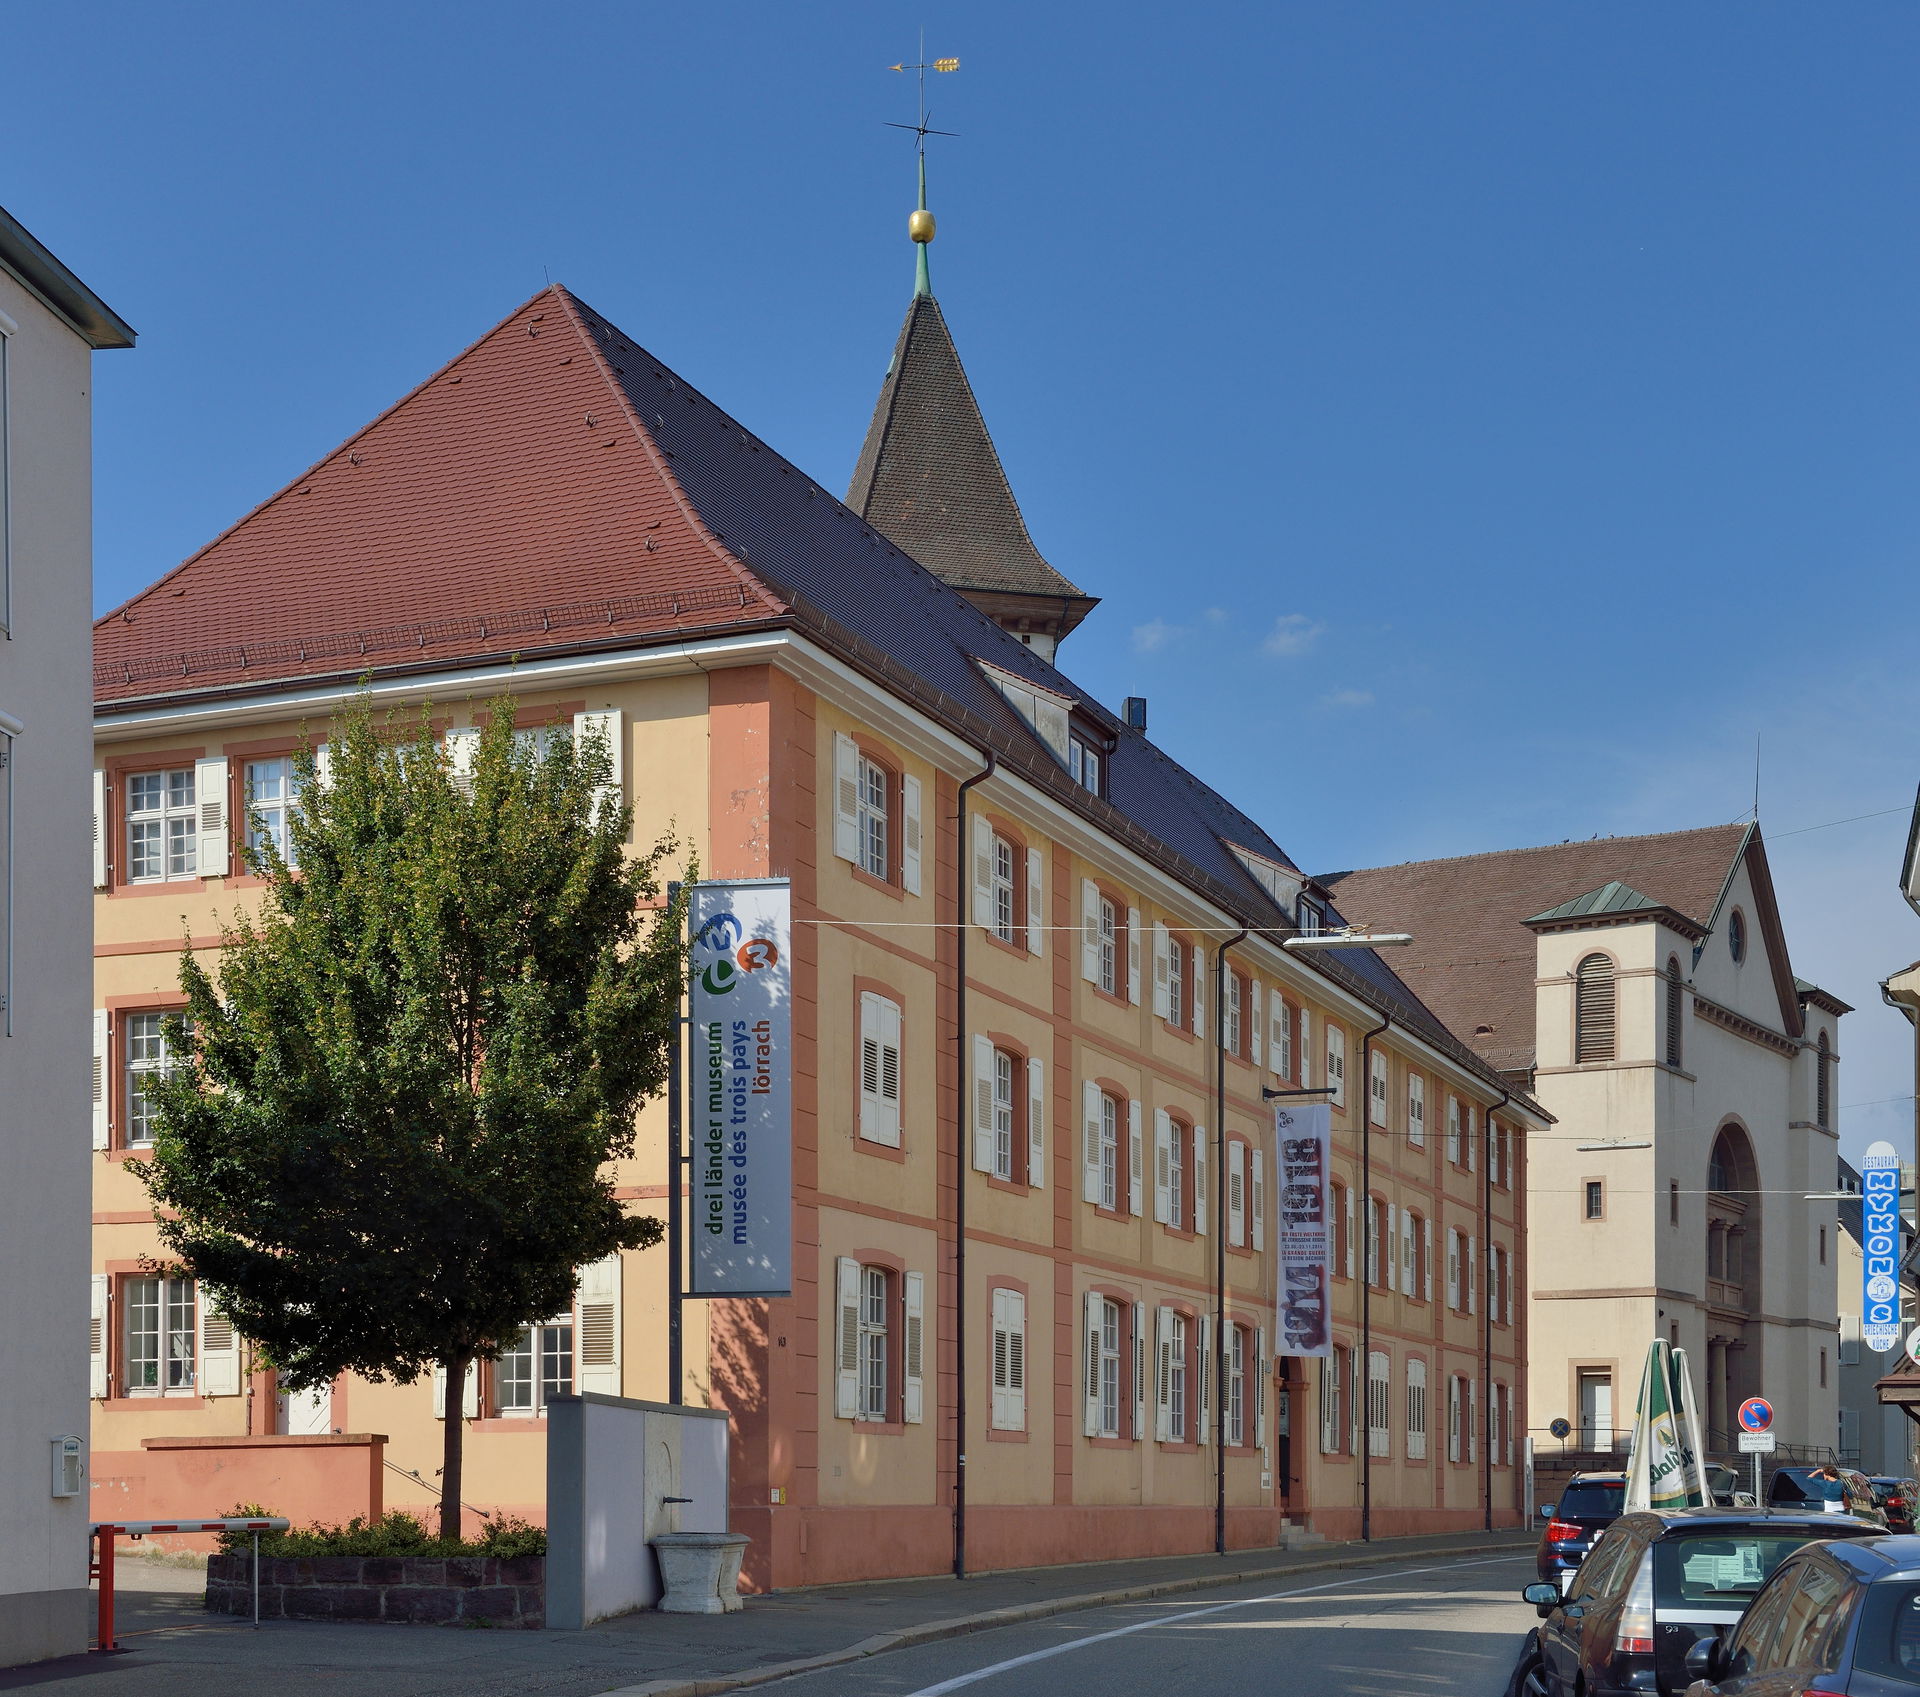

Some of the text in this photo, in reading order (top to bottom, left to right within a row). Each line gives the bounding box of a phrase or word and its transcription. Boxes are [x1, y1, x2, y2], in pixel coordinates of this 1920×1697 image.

[752, 1021, 770, 1094] lörrach
[705, 1022, 723, 1234] drei länder museum
[728, 1021, 750, 1244] musée des trois pays
[1864, 1155, 1897, 1168] RESTAURANT
[1282, 1137, 1320, 1230] 1918
[1283, 1264, 1320, 1349] 1914
[1864, 1324, 1898, 1335] GRIECHISCHE
[1872, 1337, 1889, 1350] KÜCHE
